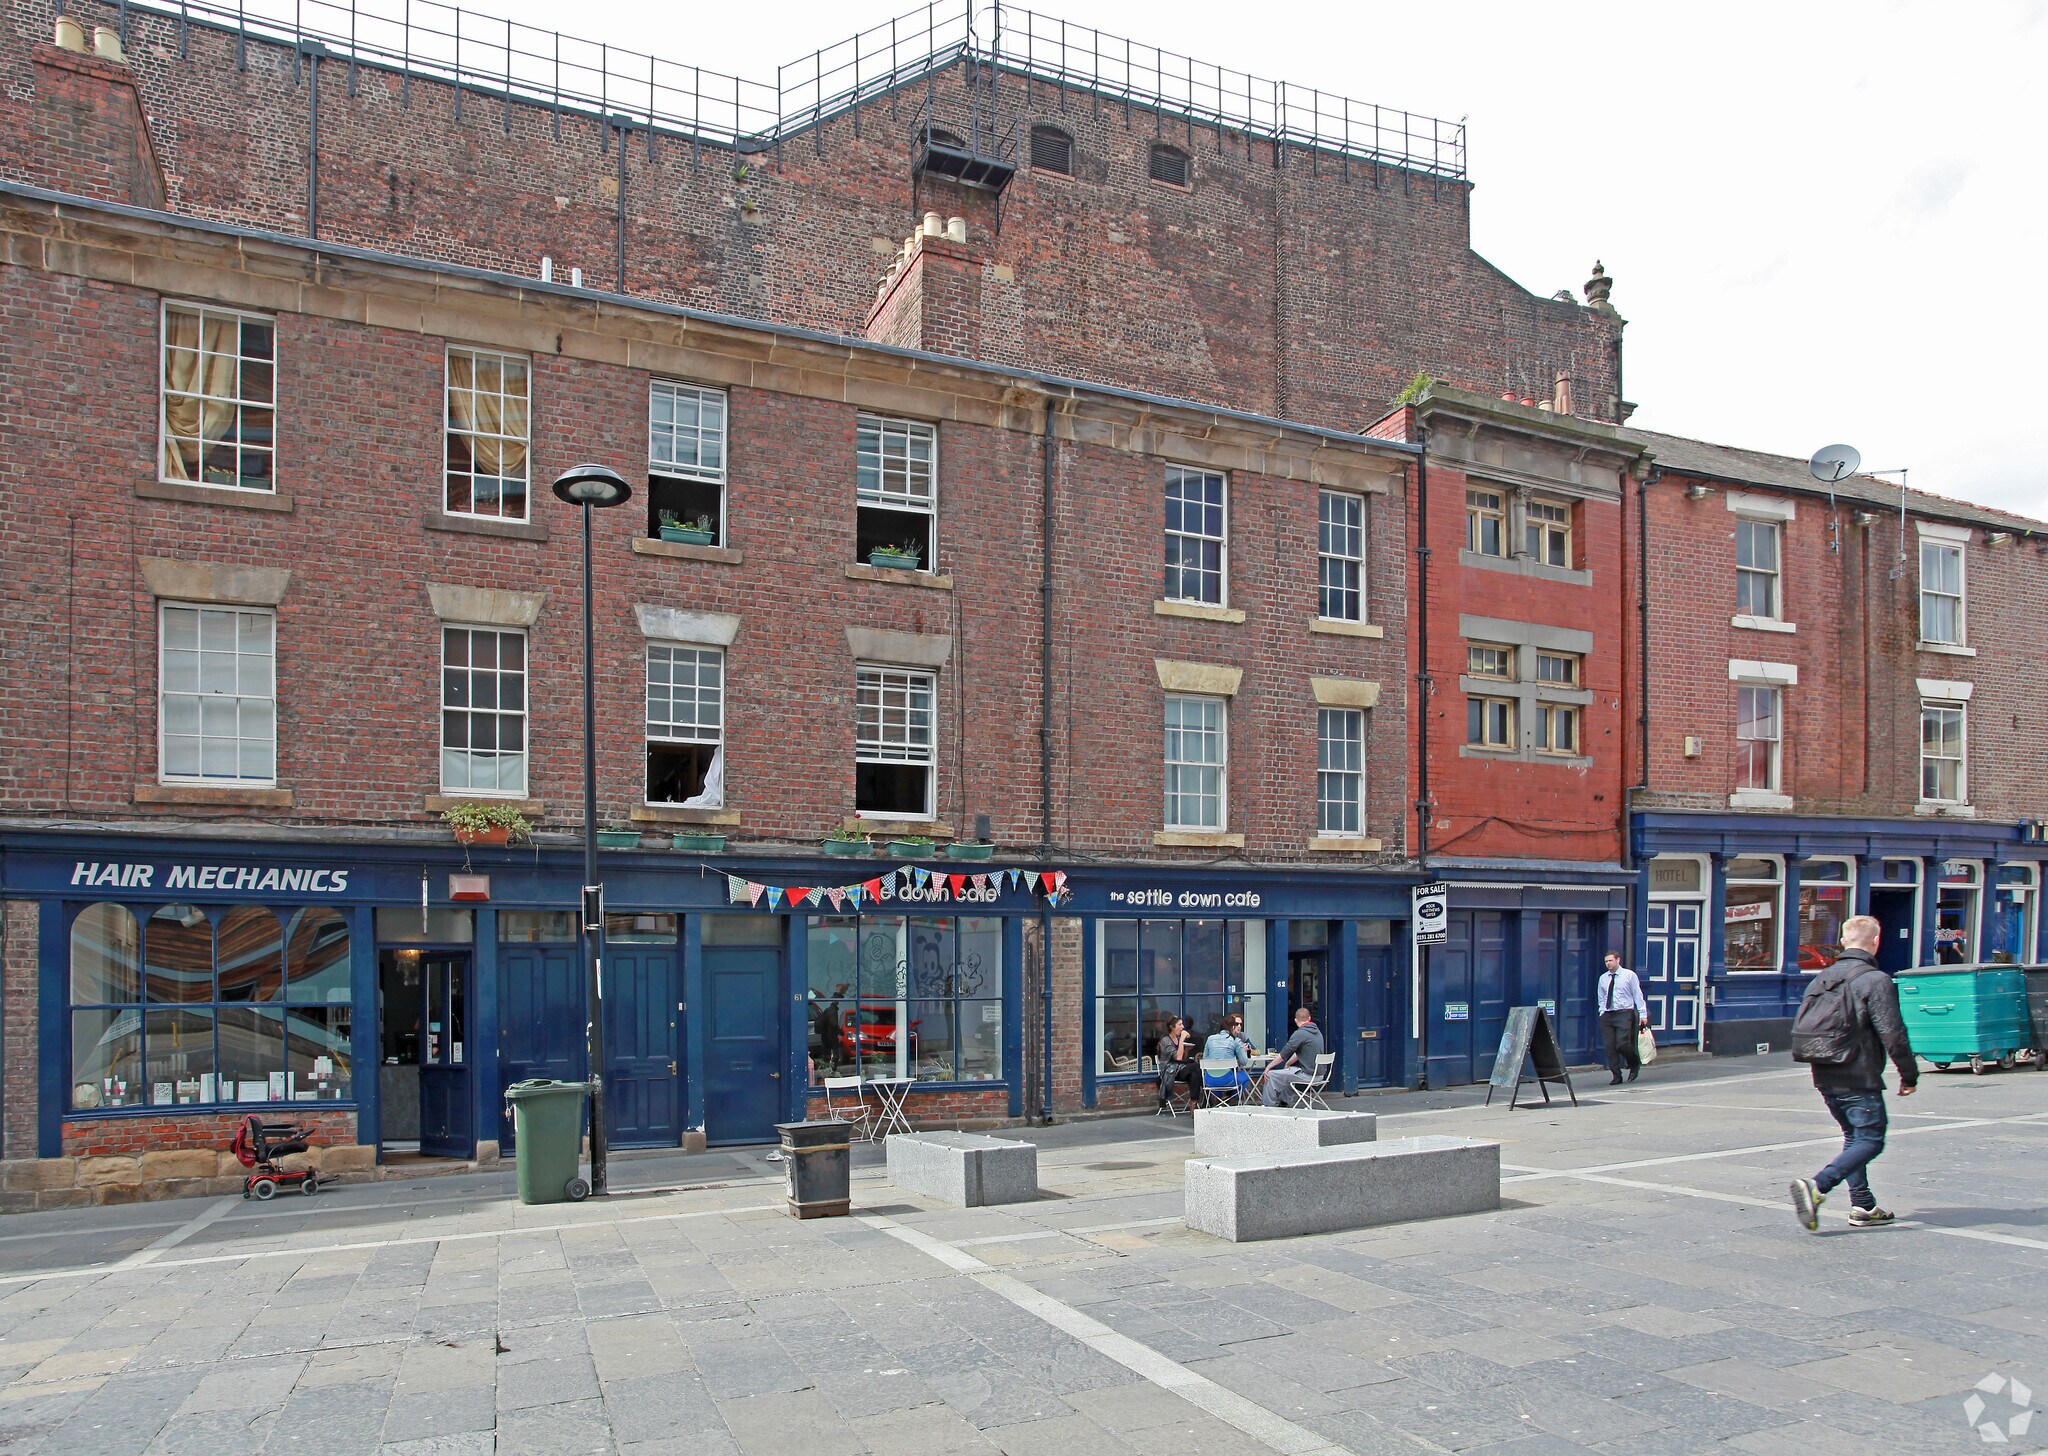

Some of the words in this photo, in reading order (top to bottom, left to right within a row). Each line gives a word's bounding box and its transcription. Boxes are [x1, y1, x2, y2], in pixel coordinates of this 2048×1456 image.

[70, 862, 154, 888] HAIR
[165, 865, 349, 892] MECHANICS
[1655, 869, 1688, 882] HOTEL
[1416, 887, 1430, 896] FOR
[1430, 884, 1445, 894] SALE
[1110, 891, 1125, 901] the
[1126, 889, 1173, 906] settle
[1178, 890, 1222, 907] down
[1224, 891, 1261, 908] cafe
[794, 993, 802, 1001] 61
